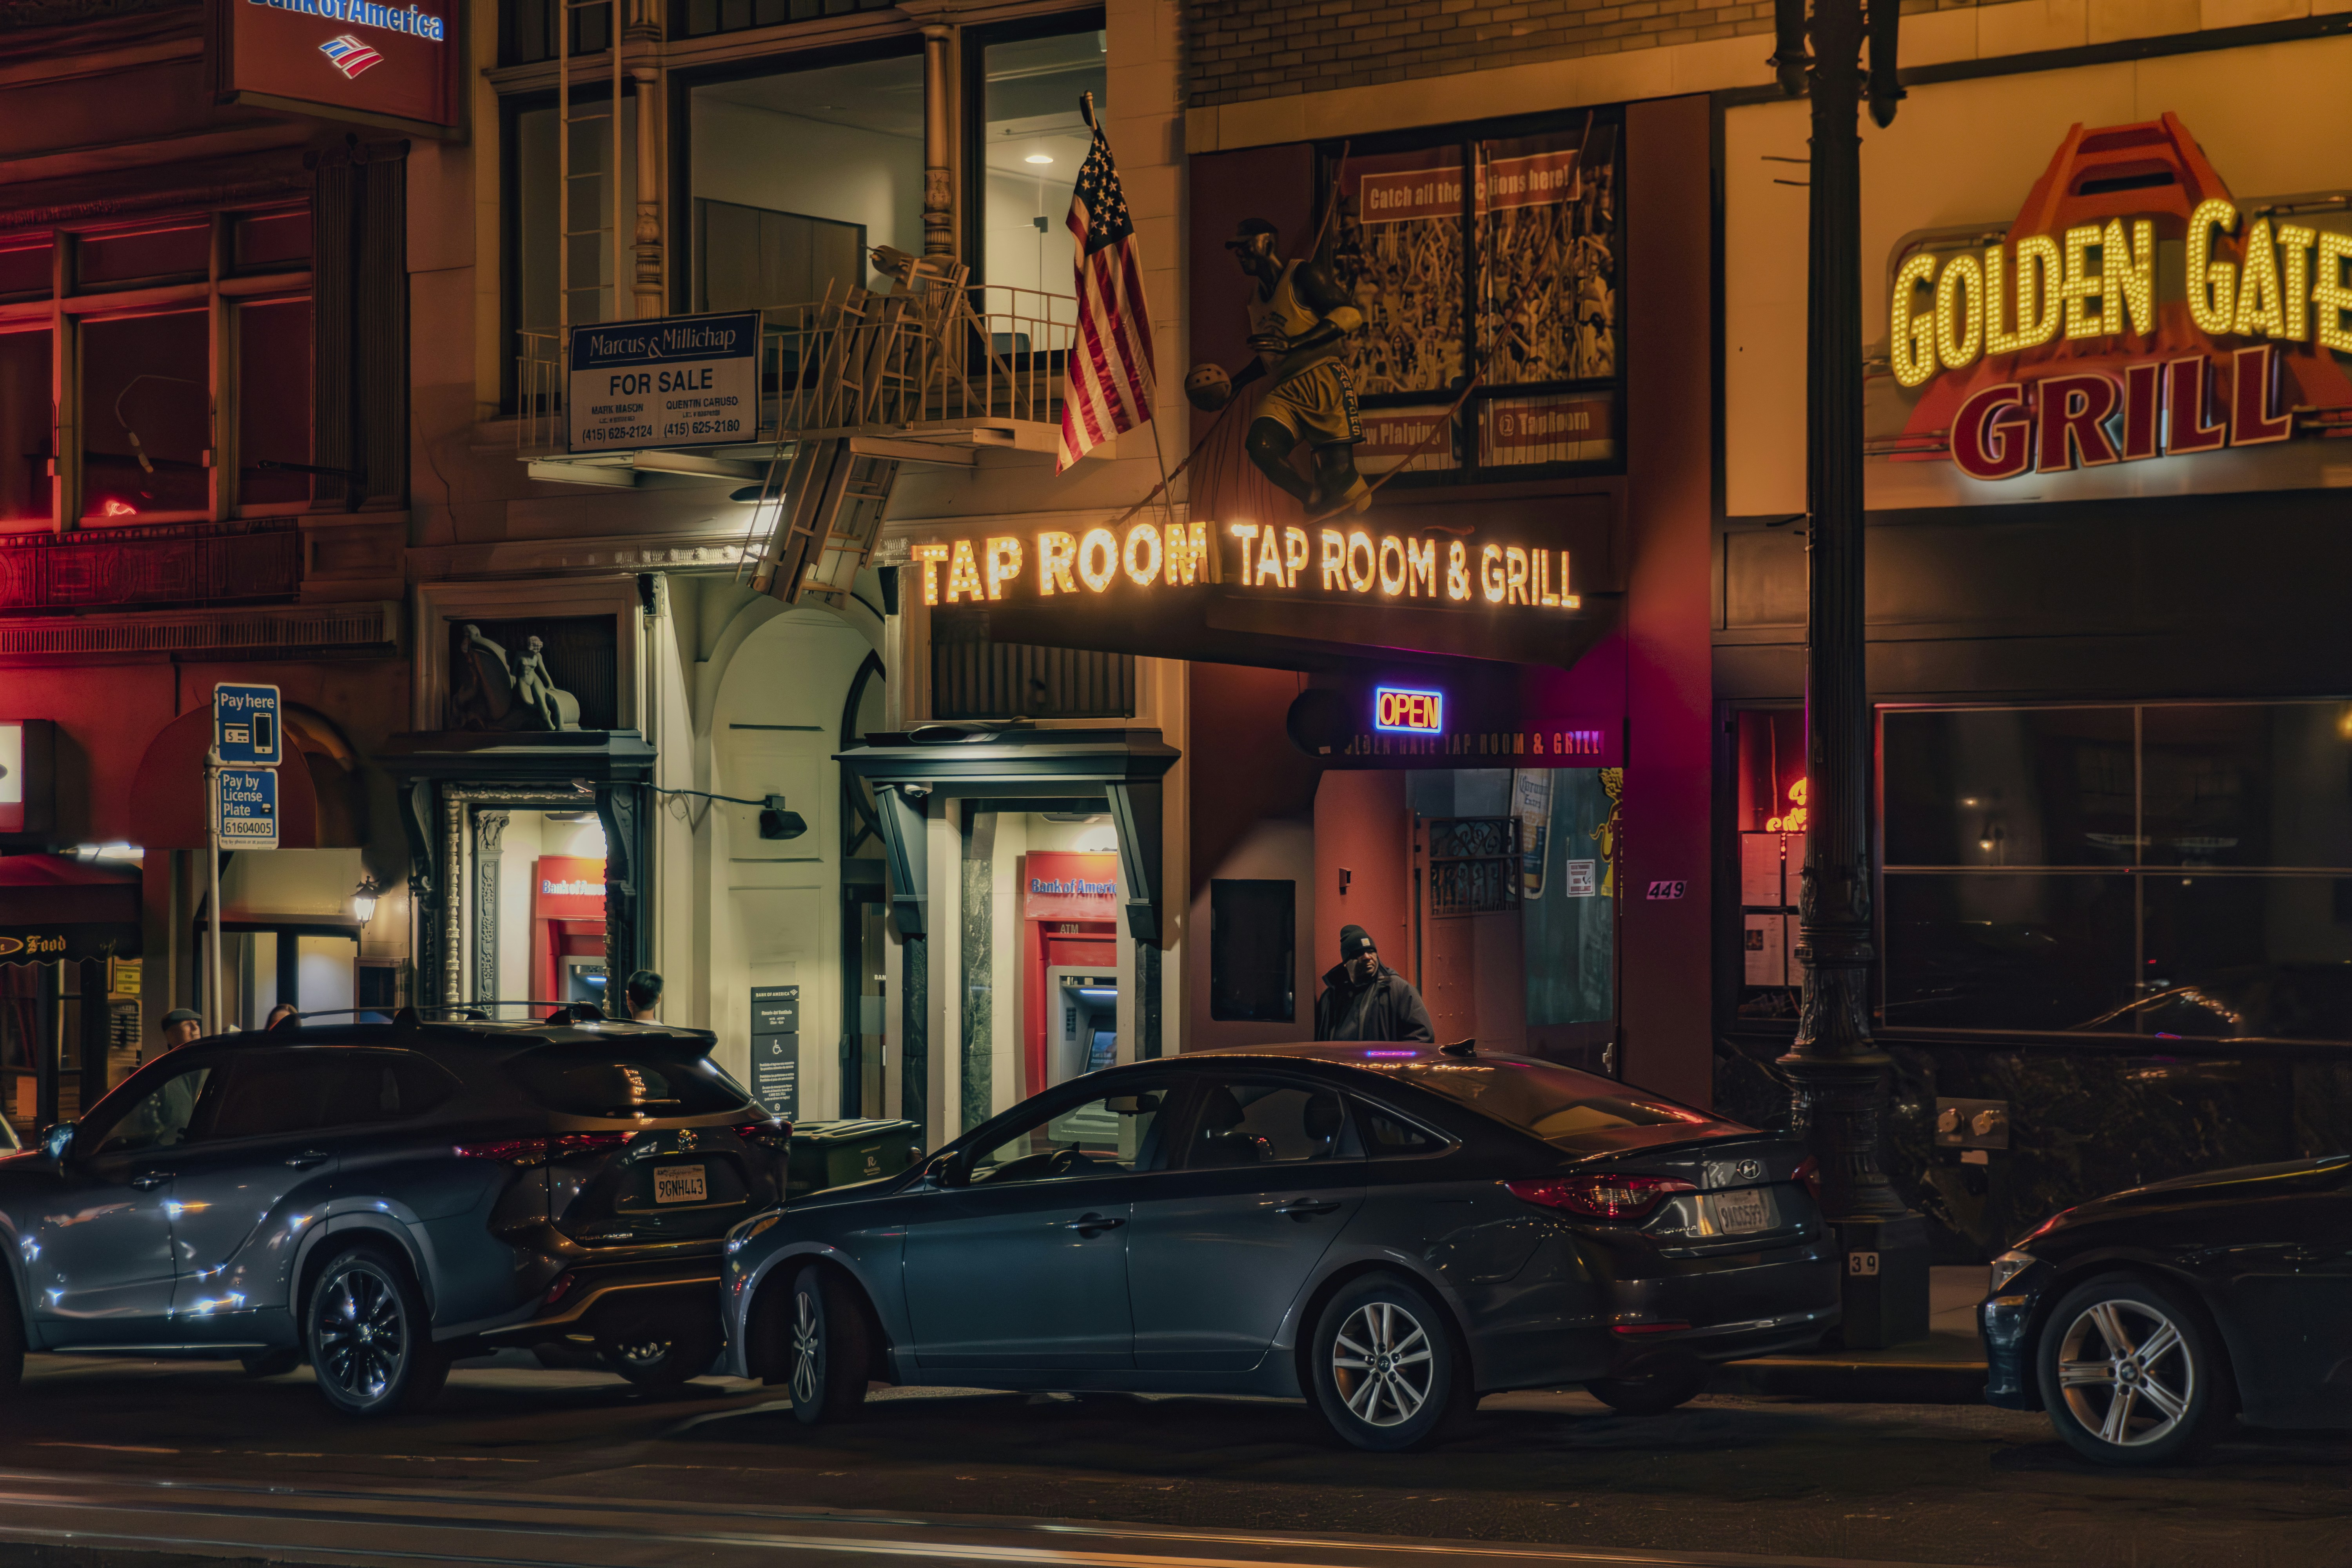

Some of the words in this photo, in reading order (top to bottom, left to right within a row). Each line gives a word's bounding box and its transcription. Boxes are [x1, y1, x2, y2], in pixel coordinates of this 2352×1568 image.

[348, 0, 444, 41] America
[1371, 186, 1412, 209] Catch
[1416, 183, 1434, 205] all
[1438, 181, 1462, 203] the
[1891, 218, 2152, 387] GOLDEN
[2187, 198, 2352, 354] GATE
[590, 335, 645, 357] Marcus
[648, 337, 663, 358] &
[663, 327, 736, 350] Millichap
[610, 374, 651, 396] FOR
[659, 368, 713, 392] SALE
[615, 403, 644, 413] MASON
[666, 398, 701, 410] QUENTIN
[703, 396, 738, 407] CARUSO
[1950, 343, 2293, 482] GRILL
[582, 429, 606, 443] (415)
[608, 424, 652, 439] 625-2124
[664, 422, 689, 438] (415)
[692, 419, 740, 434] 625-2180
[1499, 414, 1515, 437] @
[912, 536, 1022, 606] TAP
[1038, 522, 1208, 596] ROOM
[1231, 524, 1309, 588] TAP
[1321, 528, 1437, 598] ROOM
[1446, 540, 1472, 601] &
[1481, 543, 1581, 610] GRILL
[221, 693, 244, 711] Pay
[247, 694, 275, 709] here
[1379, 693, 1439, 728] OPEN
[1533, 732, 1544, 755] &
[1553, 731, 1599, 755] GRILL
[223, 774, 243, 790] Pay
[246, 774, 260, 791] by
[223, 788, 263, 802] License
[223, 803, 251, 816] Plate
[225, 822, 271, 834] 61604005
[543, 880, 569, 895] Bank
[1031, 878, 1063, 893] Bank
[1063, 878, 1076, 893] of
[1078, 879, 1116, 894] Americ
[1649, 882, 1684, 898] 449
[1060, 924, 1078, 934] ATM
[26, 935, 66, 955] Food
[1852, 1256, 1875, 1272] 39
